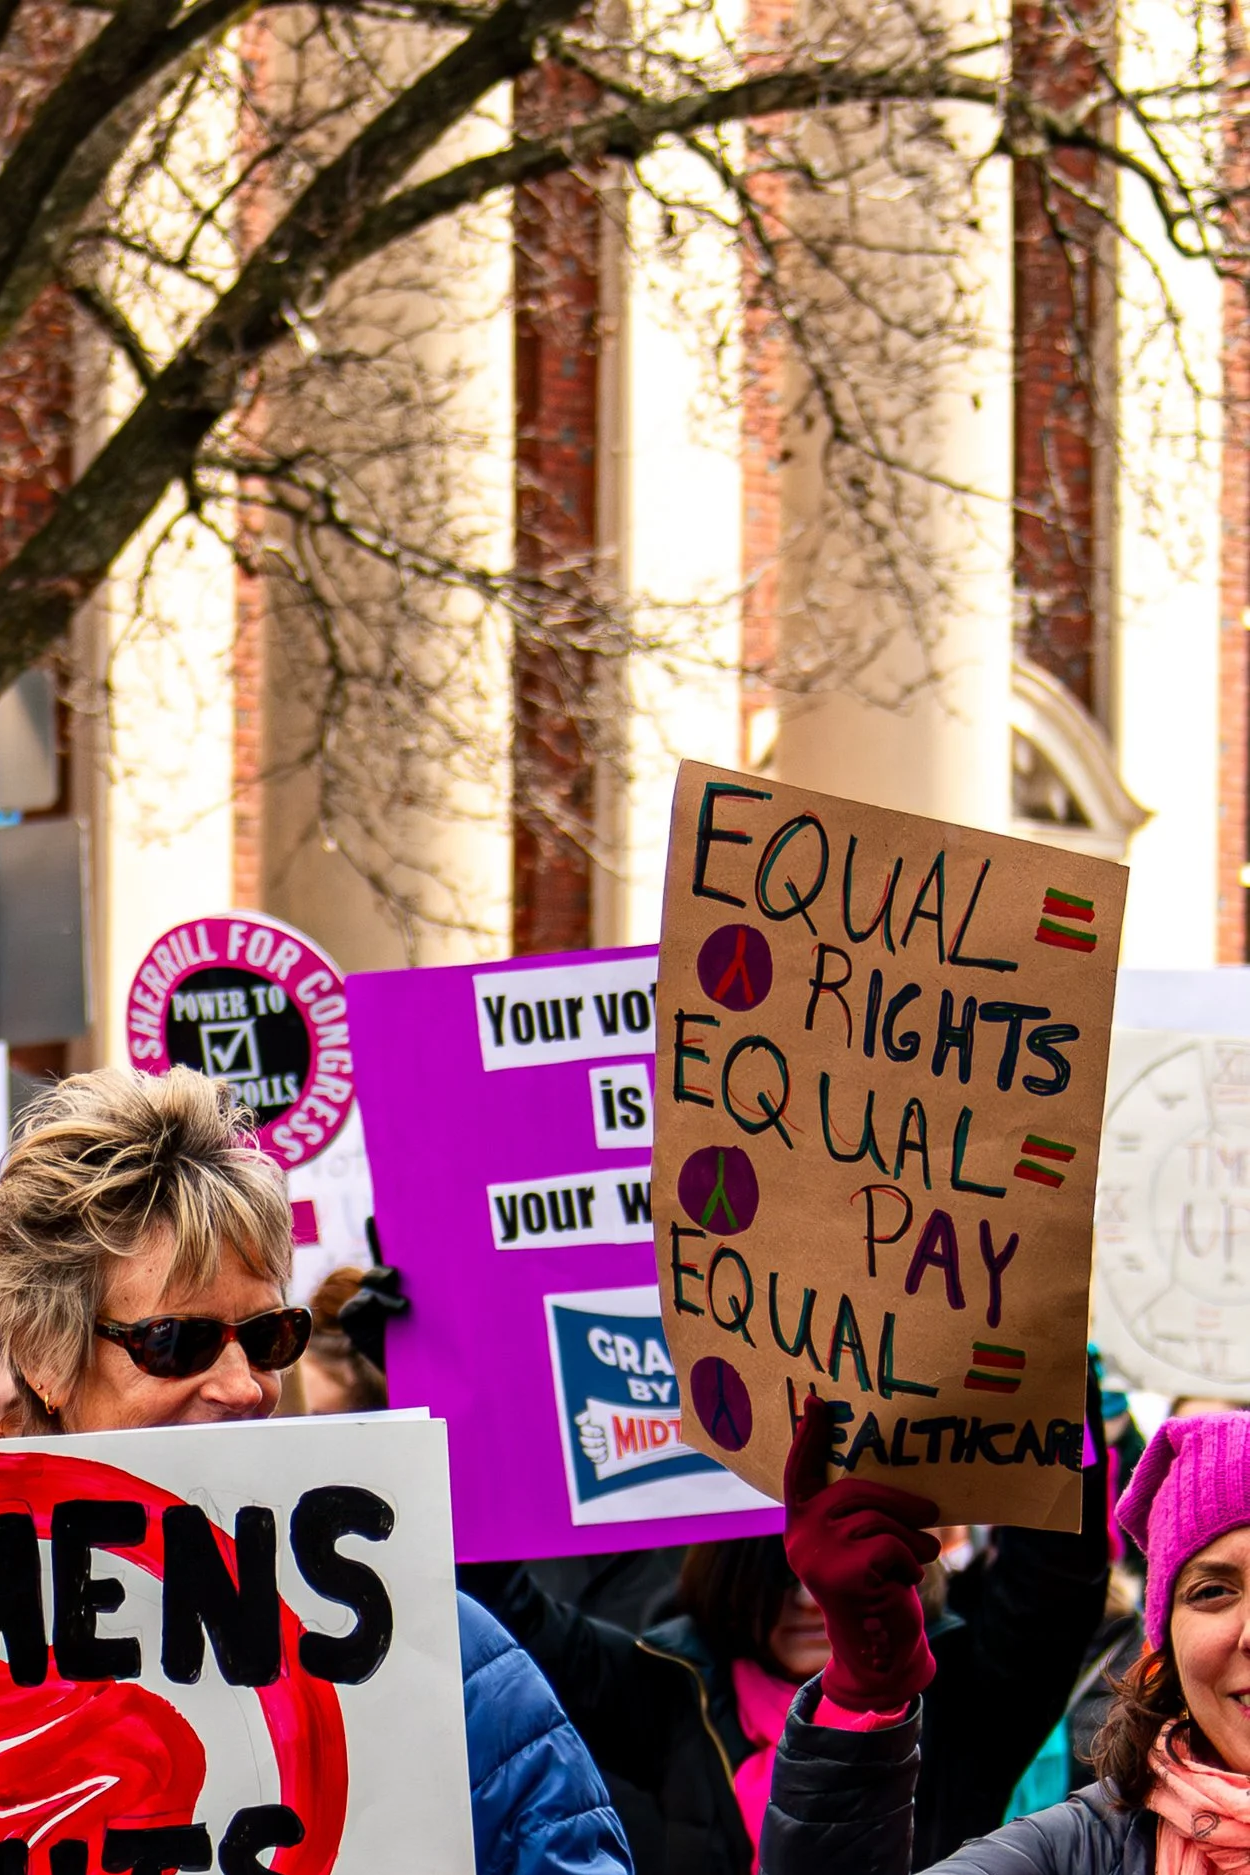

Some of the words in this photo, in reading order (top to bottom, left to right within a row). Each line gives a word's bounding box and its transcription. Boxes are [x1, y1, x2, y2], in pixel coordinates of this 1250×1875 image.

[692, 782, 1018, 972] EQUAL
[130, 923, 218, 1060] SHERRILL
[226, 921, 303, 981] FOR
[271, 969, 354, 1163] CONGRESS
[171, 990, 249, 1022] POWER
[252, 984, 288, 1017] TO
[481, 993, 584, 1048] Your
[593, 983, 656, 1037] vo
[804, 942, 1081, 1096] RIGHTS
[599, 1079, 647, 1132] is
[673, 1009, 1007, 1199] EQUAL
[494, 1186, 596, 1244] your
[850, 1184, 1019, 1330] PAY
[587, 1326, 675, 1377] GRA
[669, 1221, 939, 1401] EQUAL
[627, 1377, 673, 1404] BY
